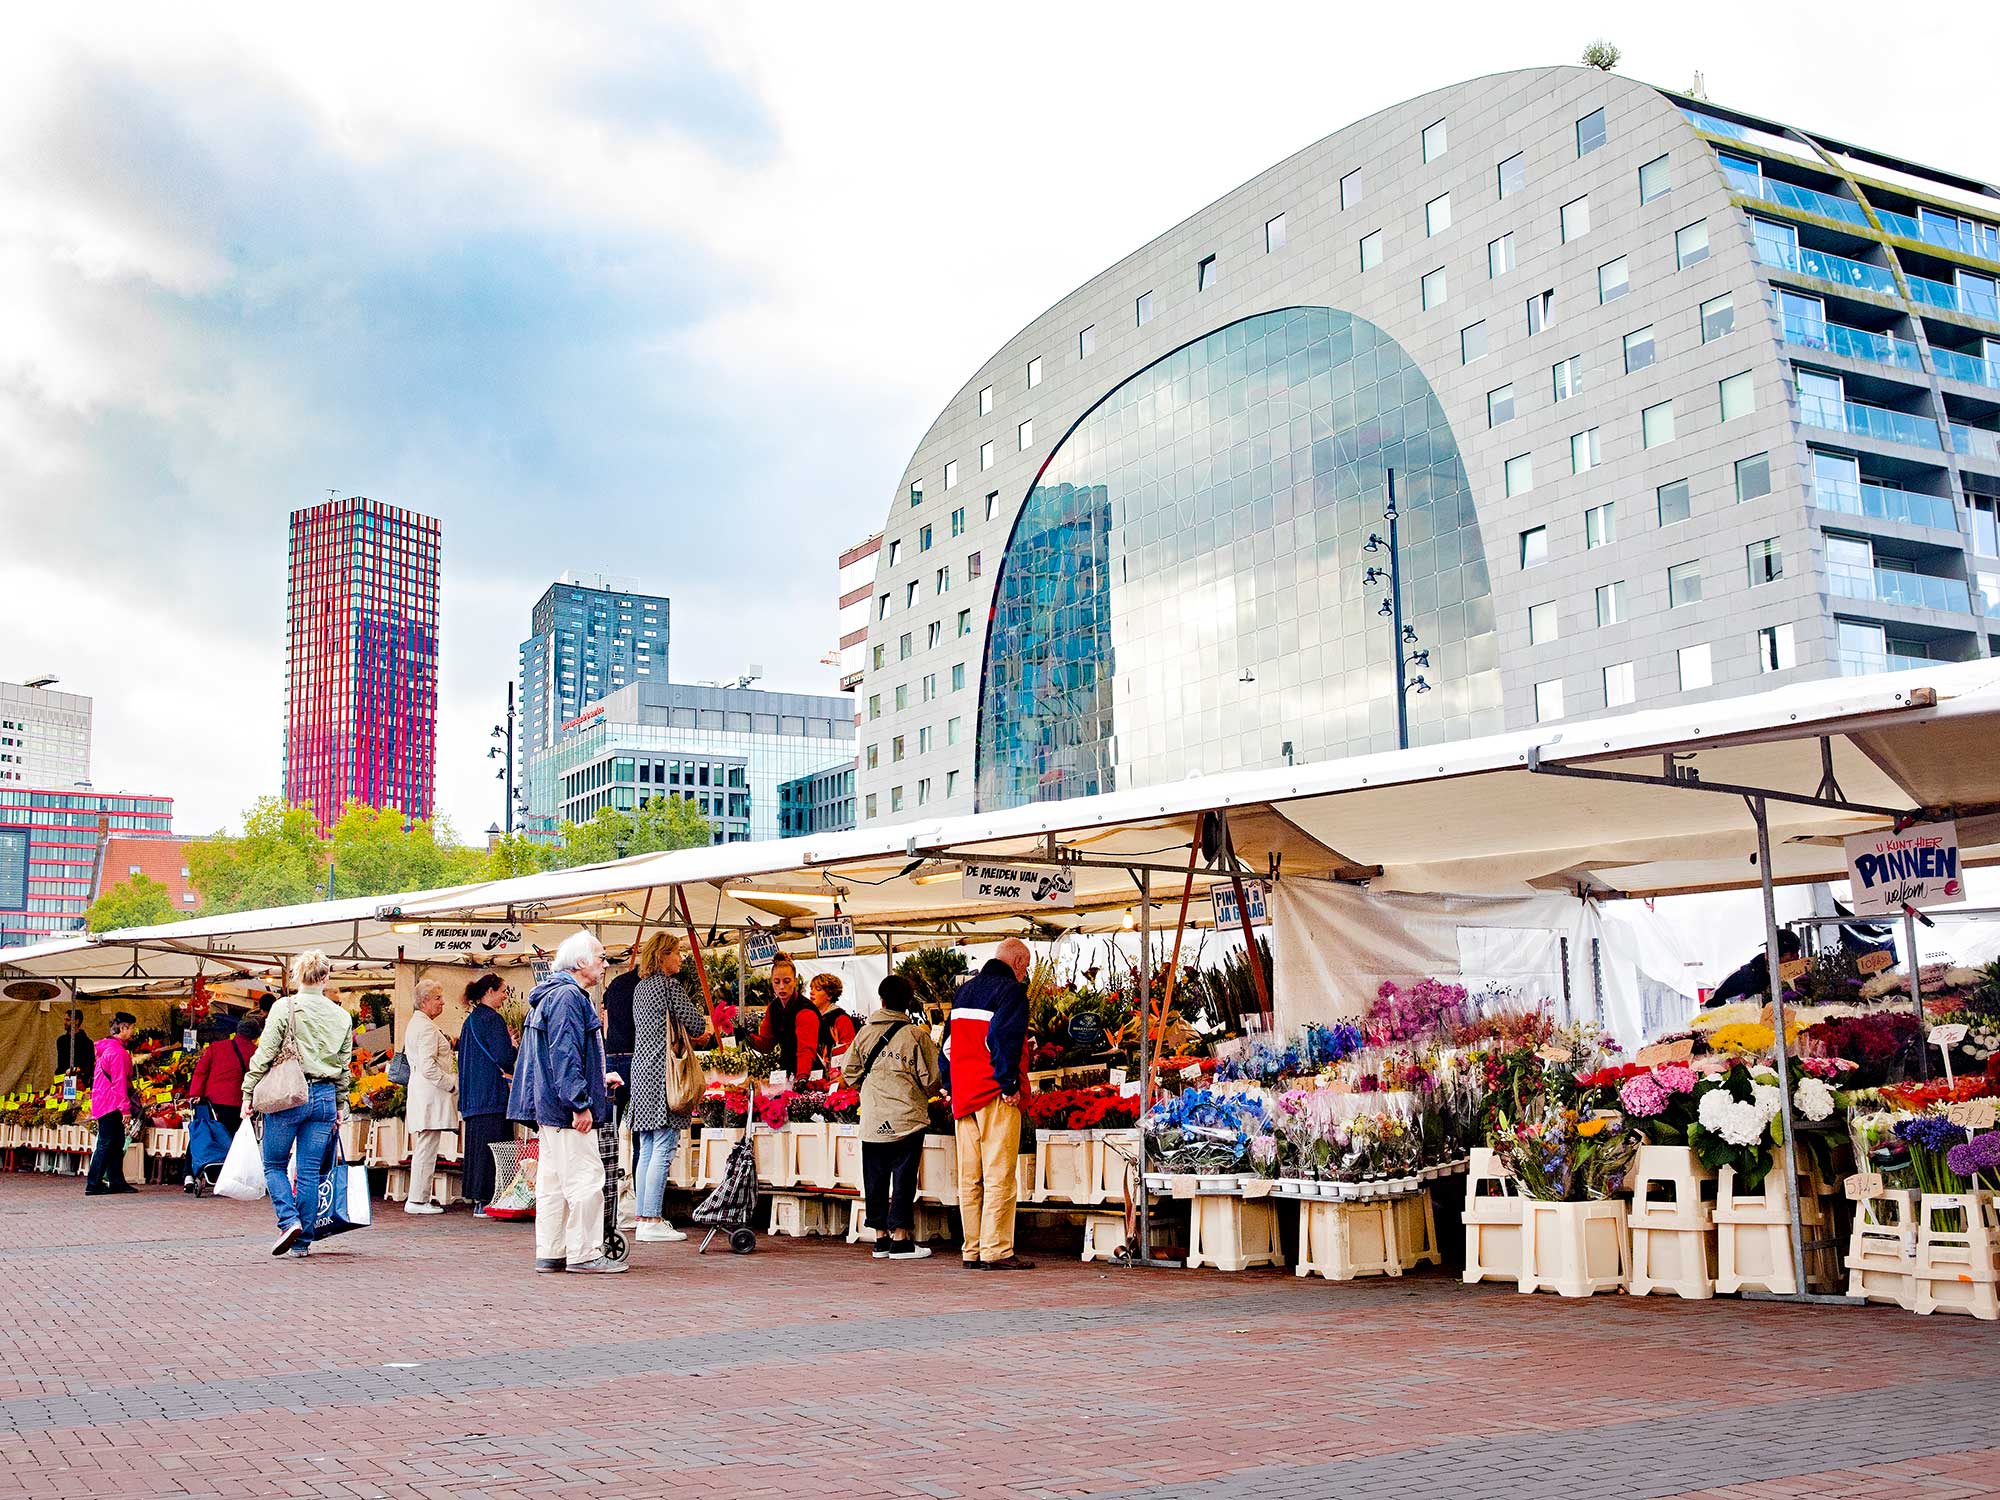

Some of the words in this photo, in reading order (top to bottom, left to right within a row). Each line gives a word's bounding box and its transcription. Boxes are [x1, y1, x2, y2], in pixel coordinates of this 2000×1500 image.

[1886, 840, 1913, 851] KUNT
[1915, 837, 1943, 848] HIER
[966, 865, 979, 876] DE
[980, 867, 1018, 881] MEIDEN
[1020, 871, 1039, 882] VAN
[1854, 846, 1957, 889] PINNEN
[979, 884, 992, 895] DE
[993, 886, 1020, 897] SNOR
[1215, 888, 1250, 907] PINNN
[1884, 880, 1928, 905] welkom
[1219, 907, 1231, 922] JA
[1232, 902, 1264, 920] GAAG
[422, 928, 434, 937] DE
[435, 928, 469, 937] MEIDEN
[470, 929, 488, 938] VAN
[817, 924, 843, 938] PINNEN
[434, 941, 446, 950] DE
[447, 941, 472, 950] SNOR
[819, 938, 829, 950] JA
[829, 937, 853, 950] GRAAG
[750, 949, 759, 961] JA
